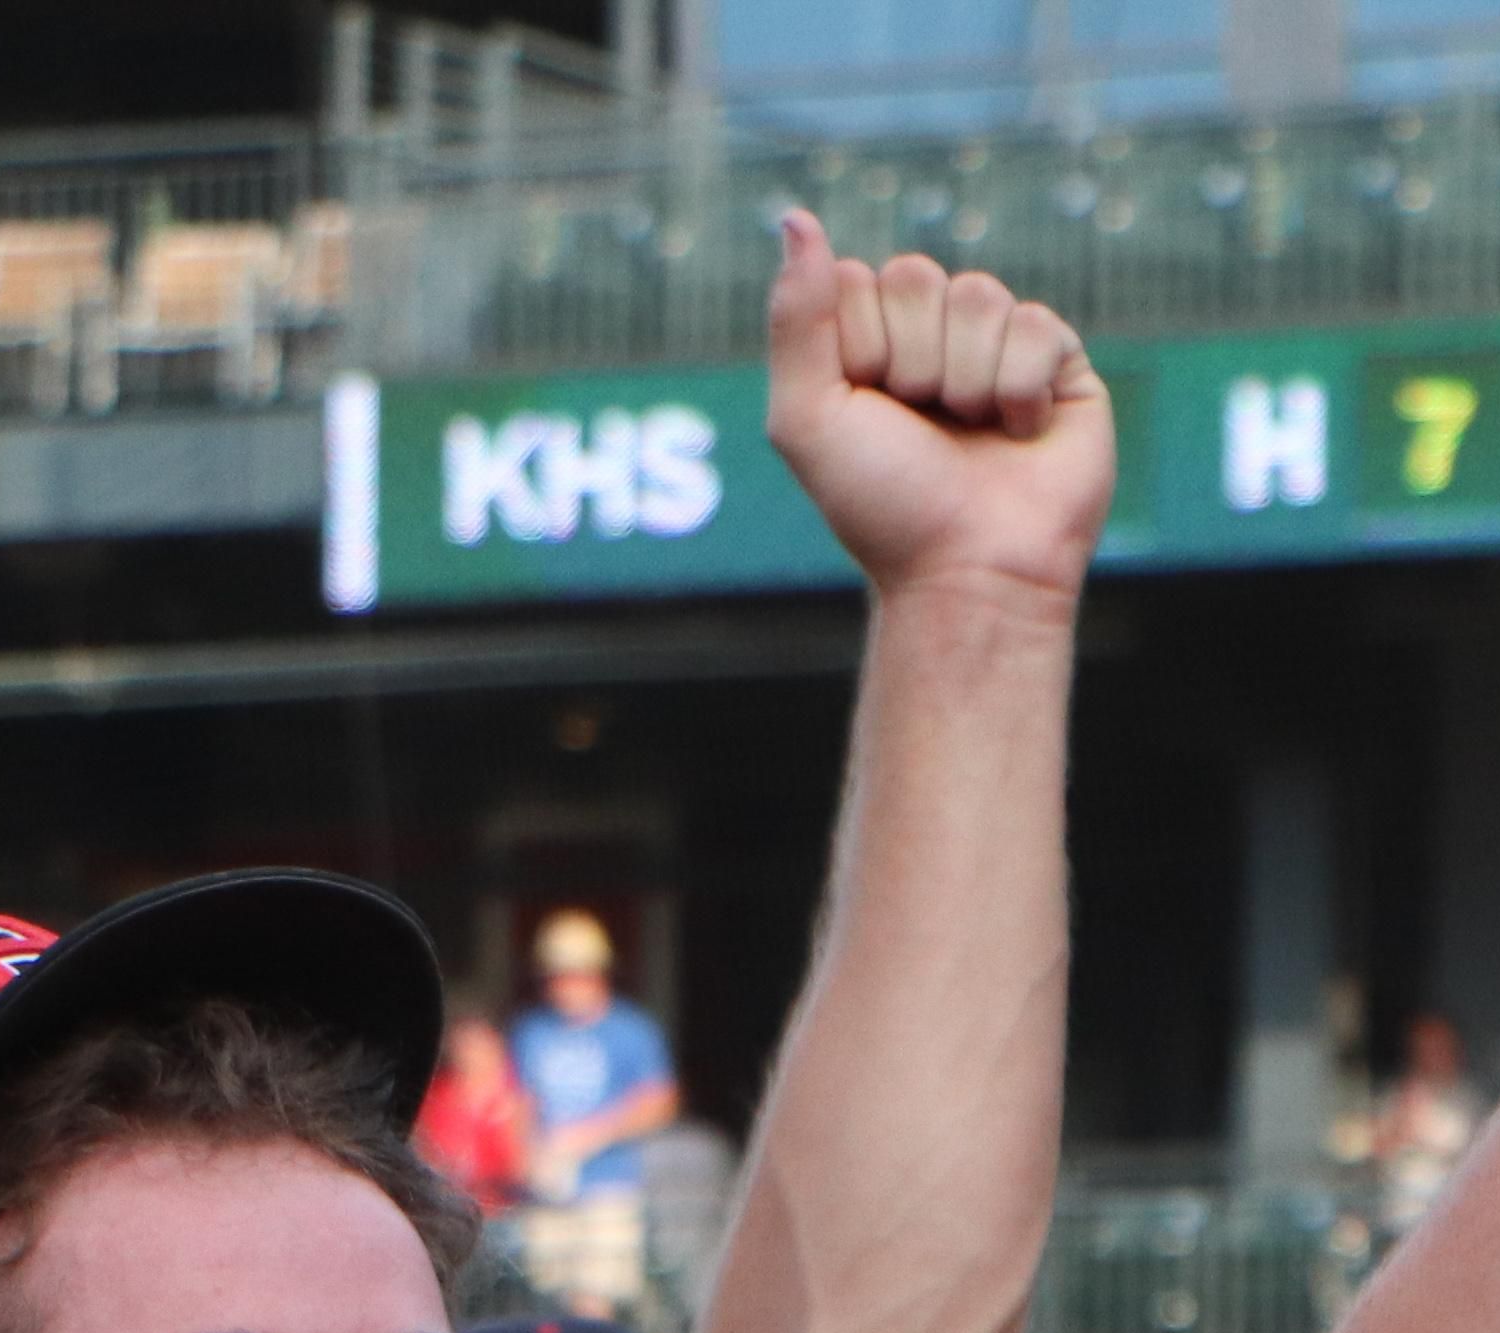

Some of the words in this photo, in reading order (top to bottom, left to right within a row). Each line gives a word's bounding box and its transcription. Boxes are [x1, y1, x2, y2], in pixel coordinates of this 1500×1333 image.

[443, 403, 722, 544] KHS
[1222, 371, 1328, 510] H
[1397, 374, 1478, 494] 7
